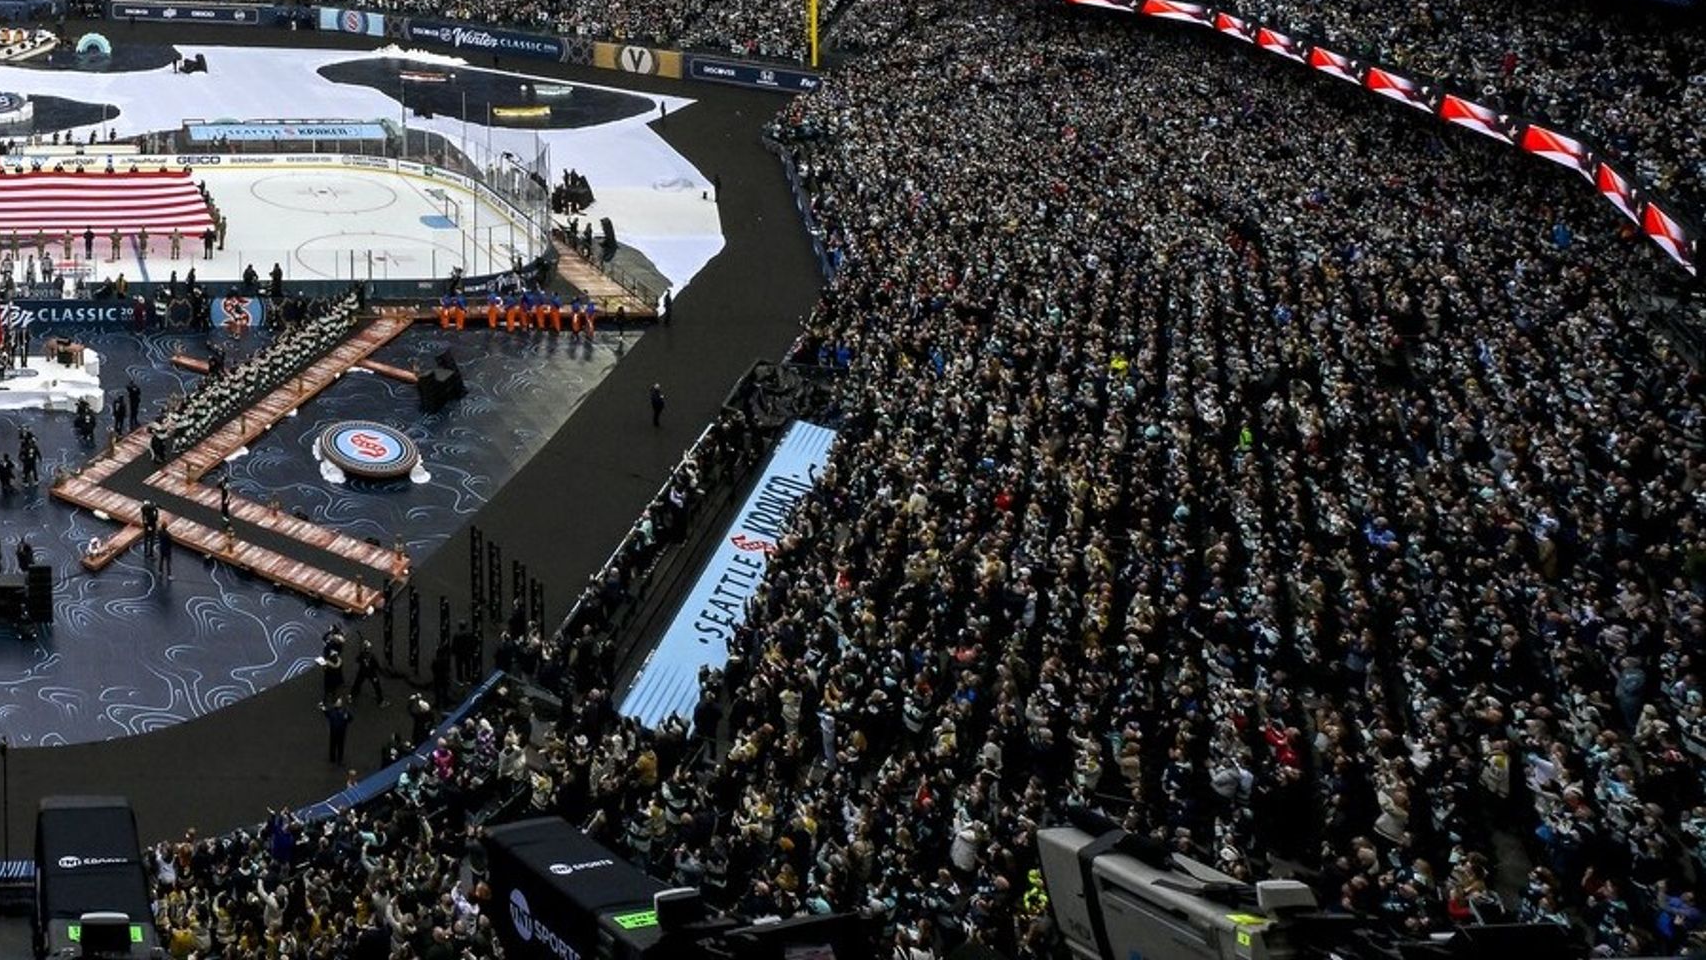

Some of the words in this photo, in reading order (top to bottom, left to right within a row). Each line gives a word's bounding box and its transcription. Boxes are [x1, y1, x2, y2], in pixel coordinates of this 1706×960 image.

[452, 26, 499, 47] Winter
[500, 38, 543, 51] CLASSIC
[176, 156, 221, 165] GEICO
[37, 308, 117, 321] CLASSIC
[694, 554, 763, 640] SEATTLE
[572, 858, 614, 871] SPORTS
